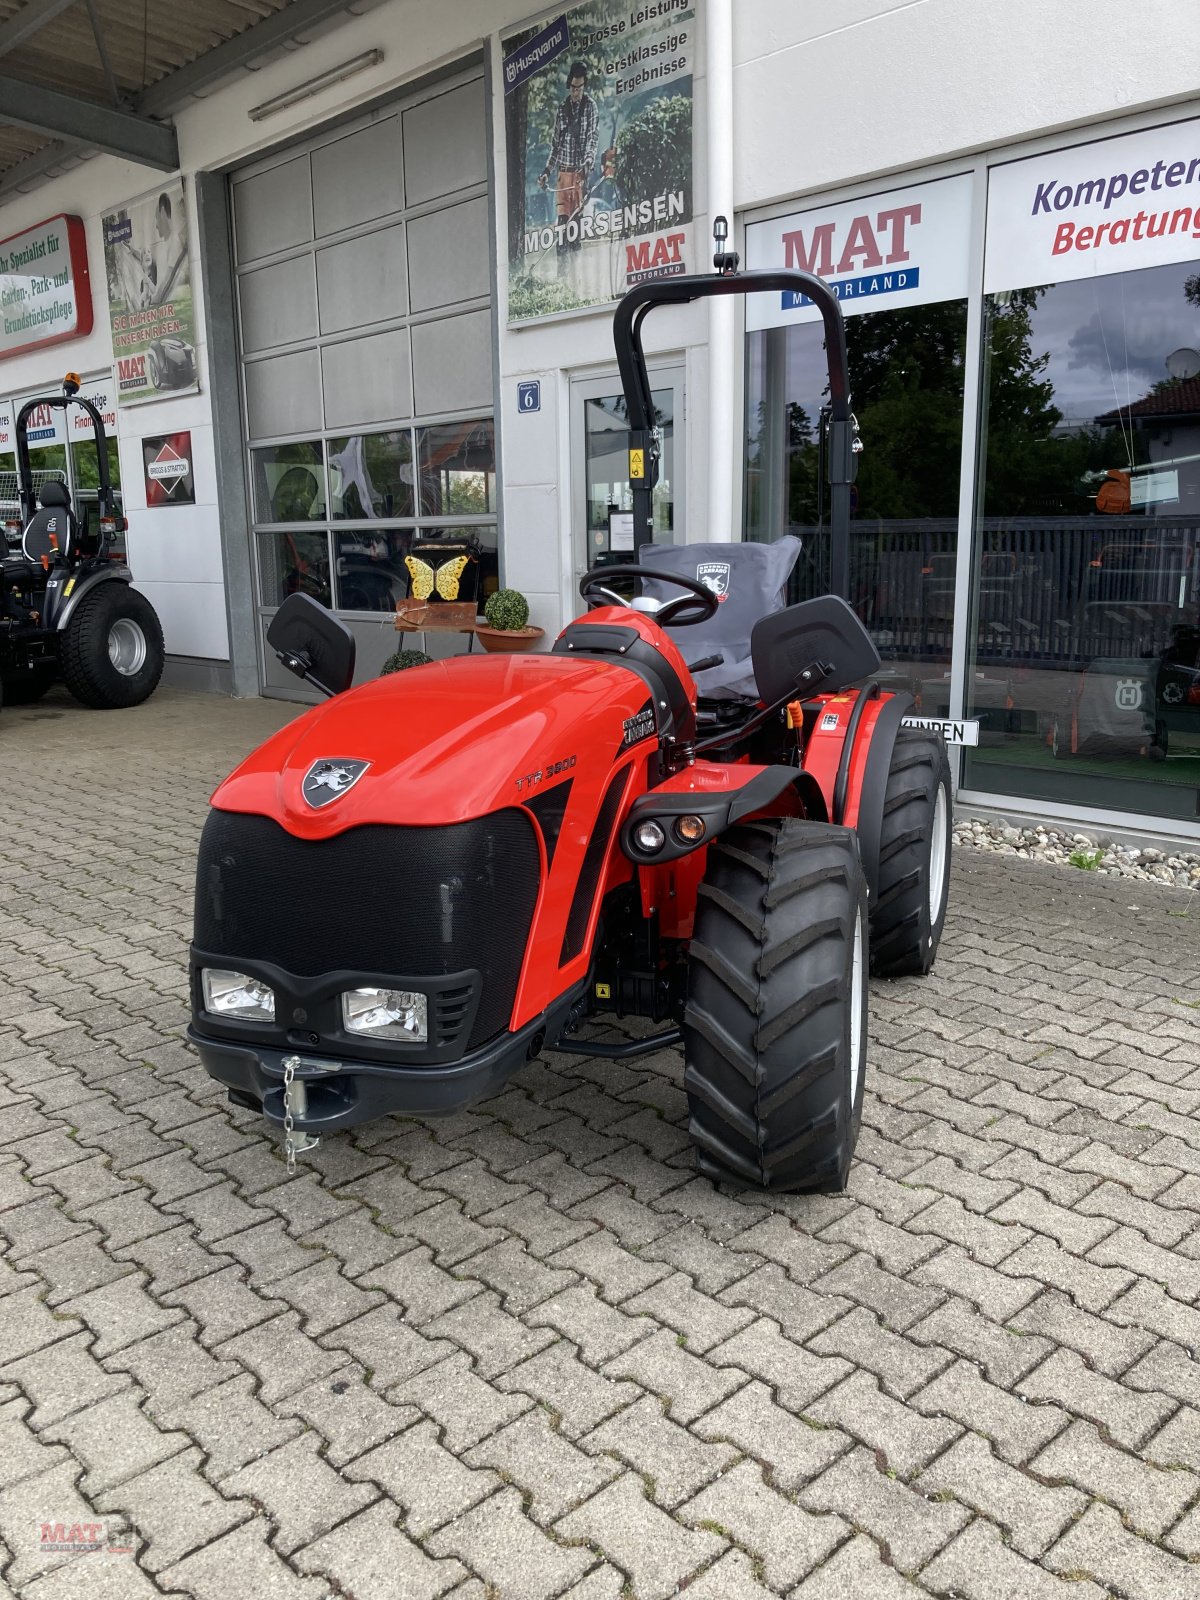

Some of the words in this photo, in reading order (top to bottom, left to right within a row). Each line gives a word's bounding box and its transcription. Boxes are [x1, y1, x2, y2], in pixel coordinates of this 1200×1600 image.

[582, 21, 625, 50] grosse
[630, 0, 688, 26] Leistung
[516, 31, 562, 74] Husqvarna
[606, 33, 687, 75] erstklassige
[616, 57, 686, 95] Ergebnisse
[524, 191, 684, 254] MOTORSENSEN
[782, 203, 921, 276] MAT
[10, 241, 46, 271] Spezialist
[48, 234, 59, 255] für
[626, 233, 685, 273] MAT
[31, 275, 52, 296] Park-
[54, 267, 69, 288] und
[631, 265, 680, 282] MOTORLAND
[793, 274, 907, 304] MORLAND
[5, 301, 72, 334] Grundstückspflege
[118, 356, 145, 380] MAT
[525, 390, 533, 407] 6
[515, 771, 542, 791] TTR
